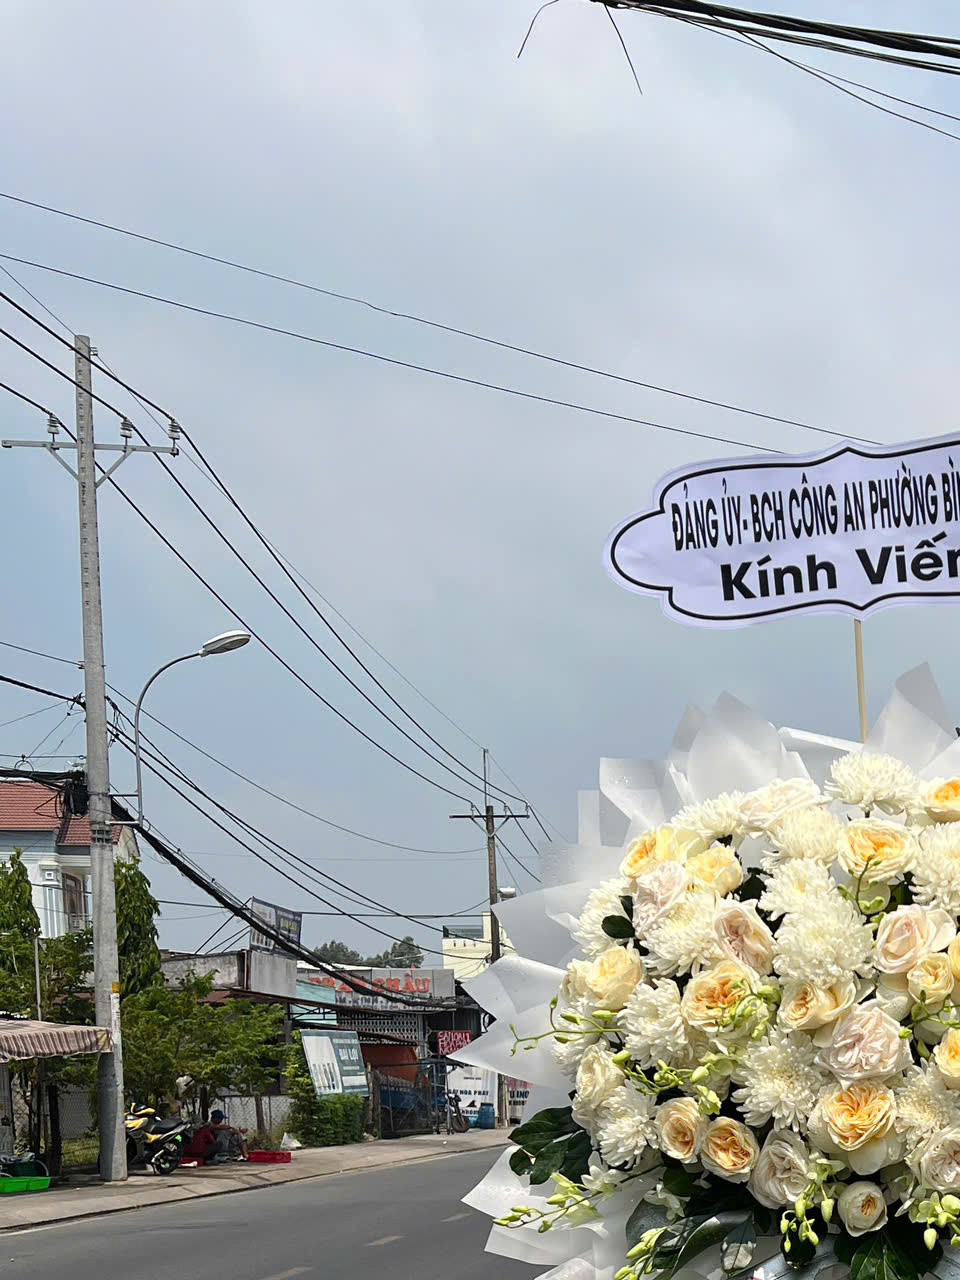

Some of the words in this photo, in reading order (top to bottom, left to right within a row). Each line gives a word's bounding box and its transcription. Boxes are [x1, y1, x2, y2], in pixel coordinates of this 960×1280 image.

[672, 482, 719, 551] ĐẢNG
[789, 472, 838, 539] CÔNG
[844, 481, 866, 532] AN
[868, 460, 938, 529] PHƯỜNG
[720, 554, 838, 601] Kính
